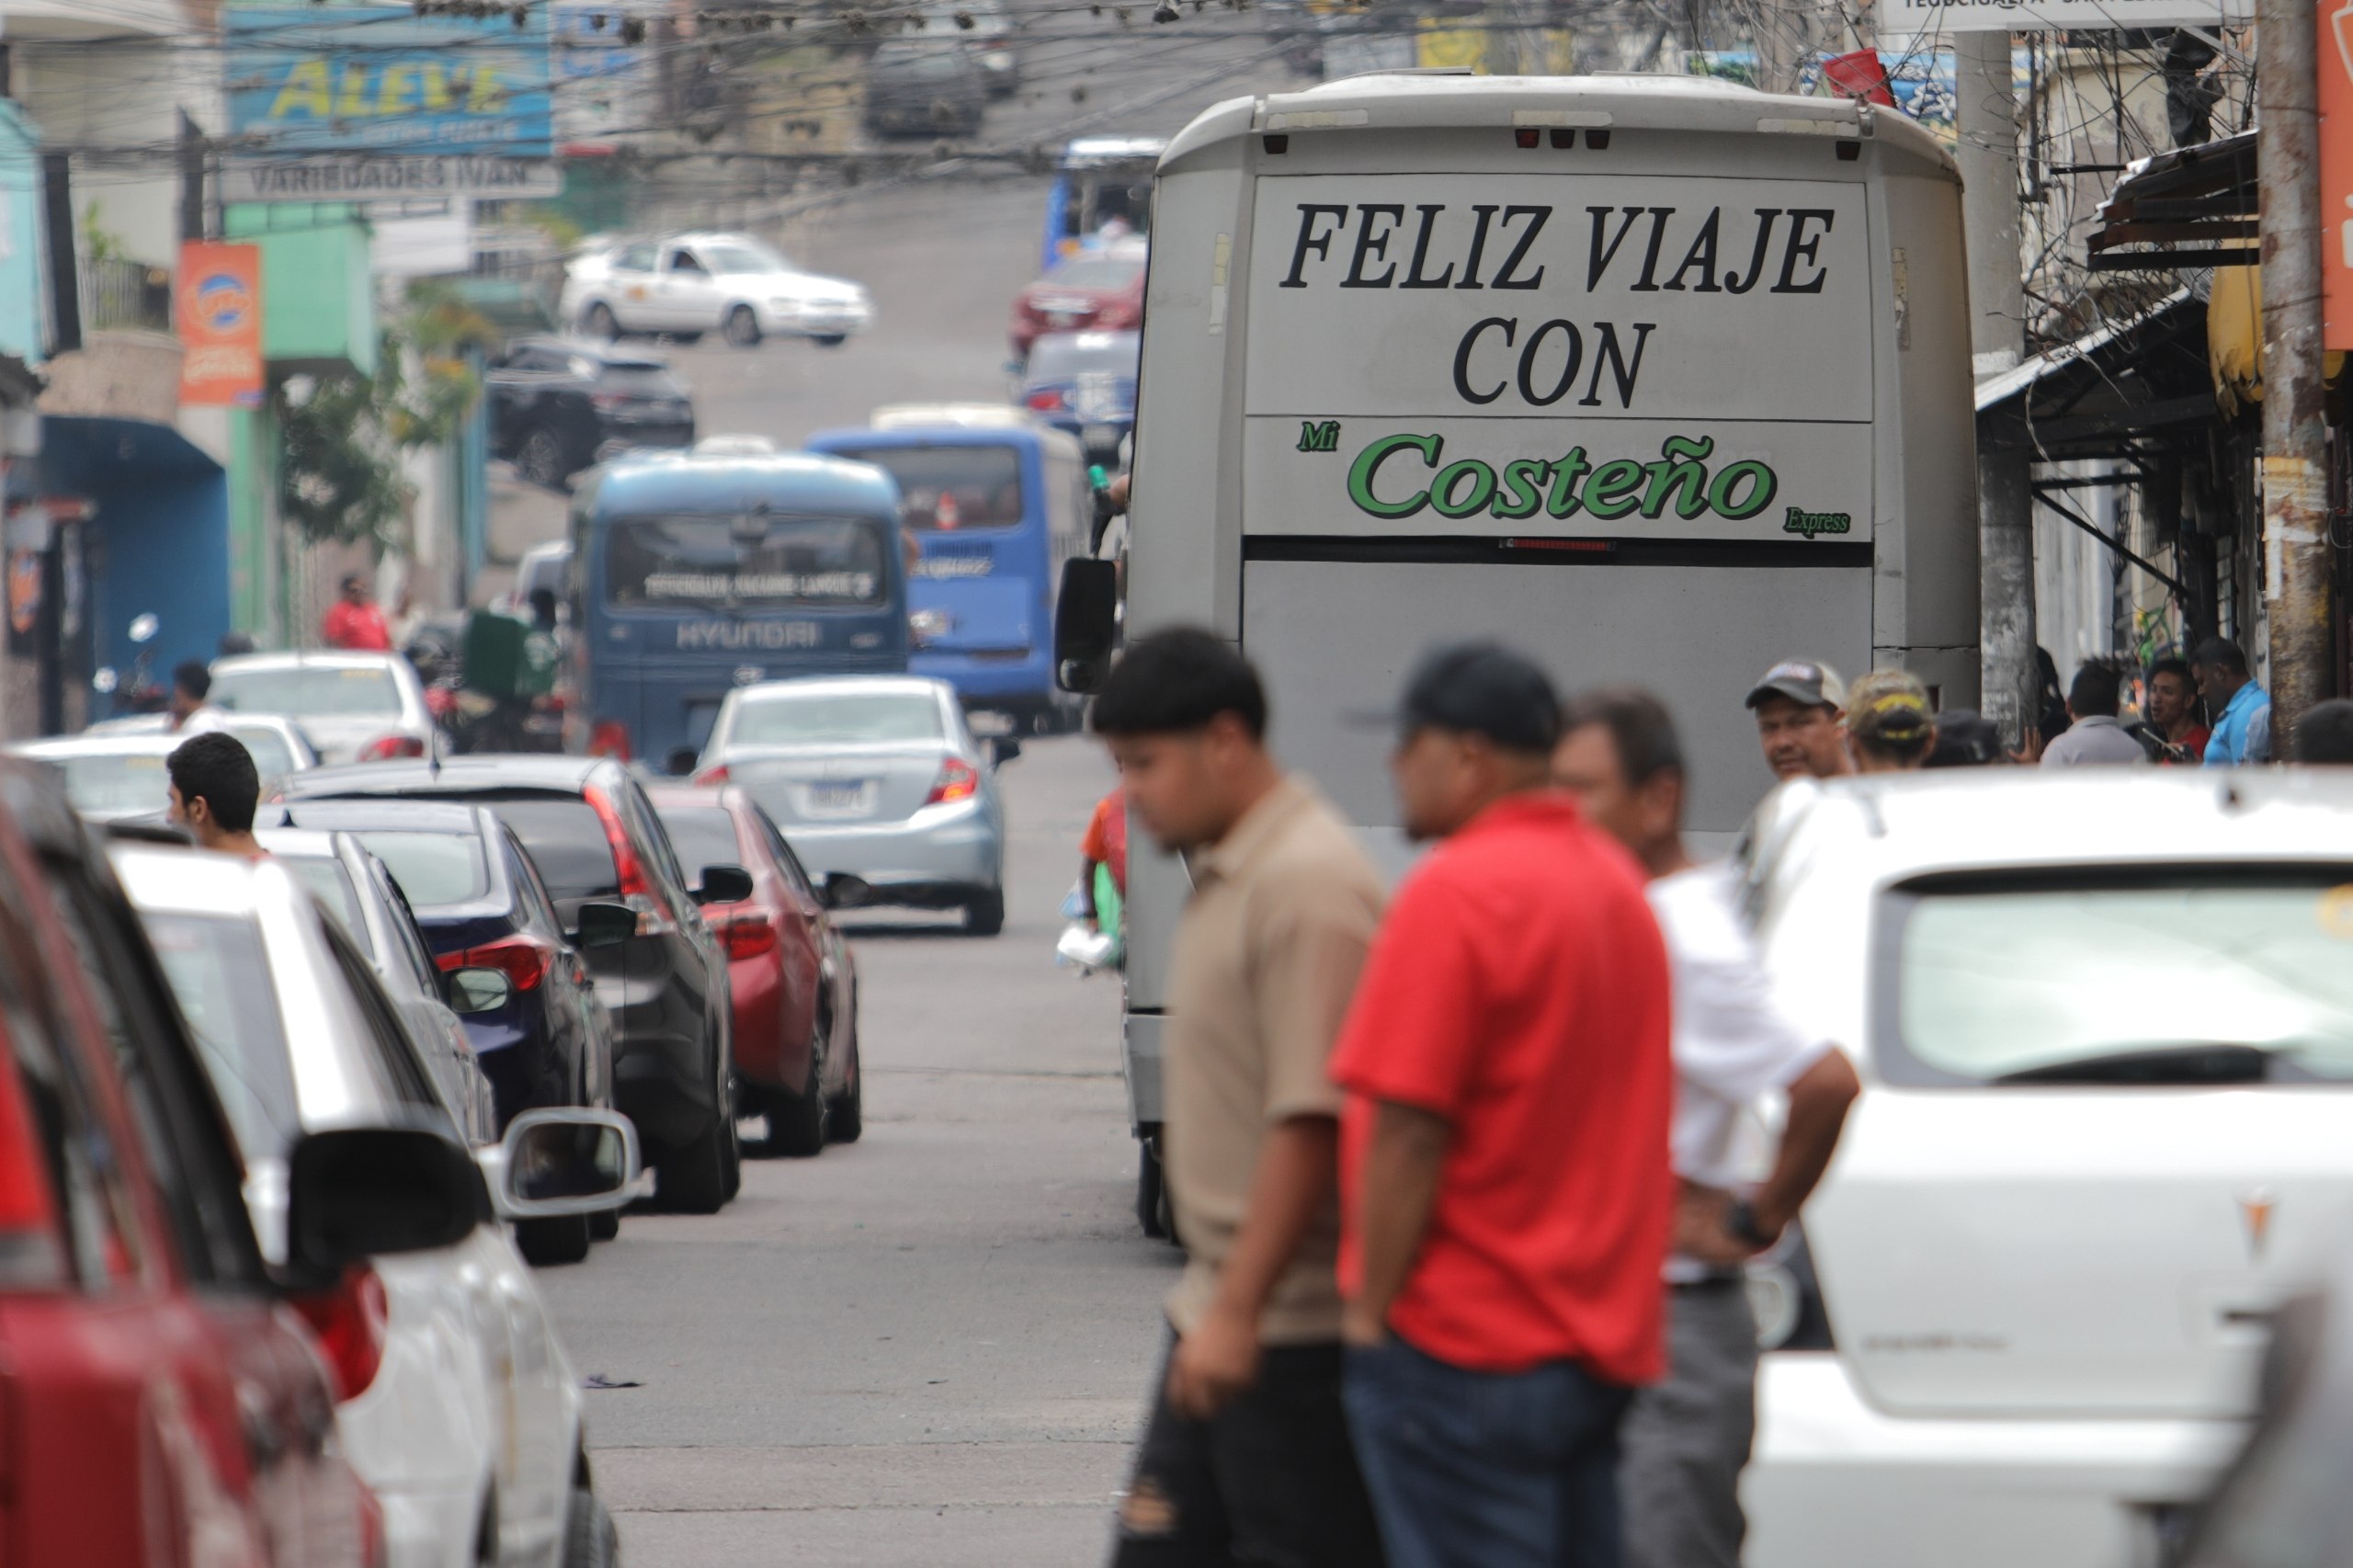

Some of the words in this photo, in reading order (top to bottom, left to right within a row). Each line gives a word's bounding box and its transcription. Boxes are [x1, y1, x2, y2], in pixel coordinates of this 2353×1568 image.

[250, 156, 444, 193] VARIEDADES
[1279, 203, 1553, 290] FELIZ
[1585, 206, 1835, 295] VIAJE
[1453, 316, 1657, 409] CON
[1296, 420, 1341, 452] Mi
[1347, 433, 1778, 520] Costeño
[1782, 506, 1851, 540] Express
[676, 619, 821, 649] HYUNDAI
